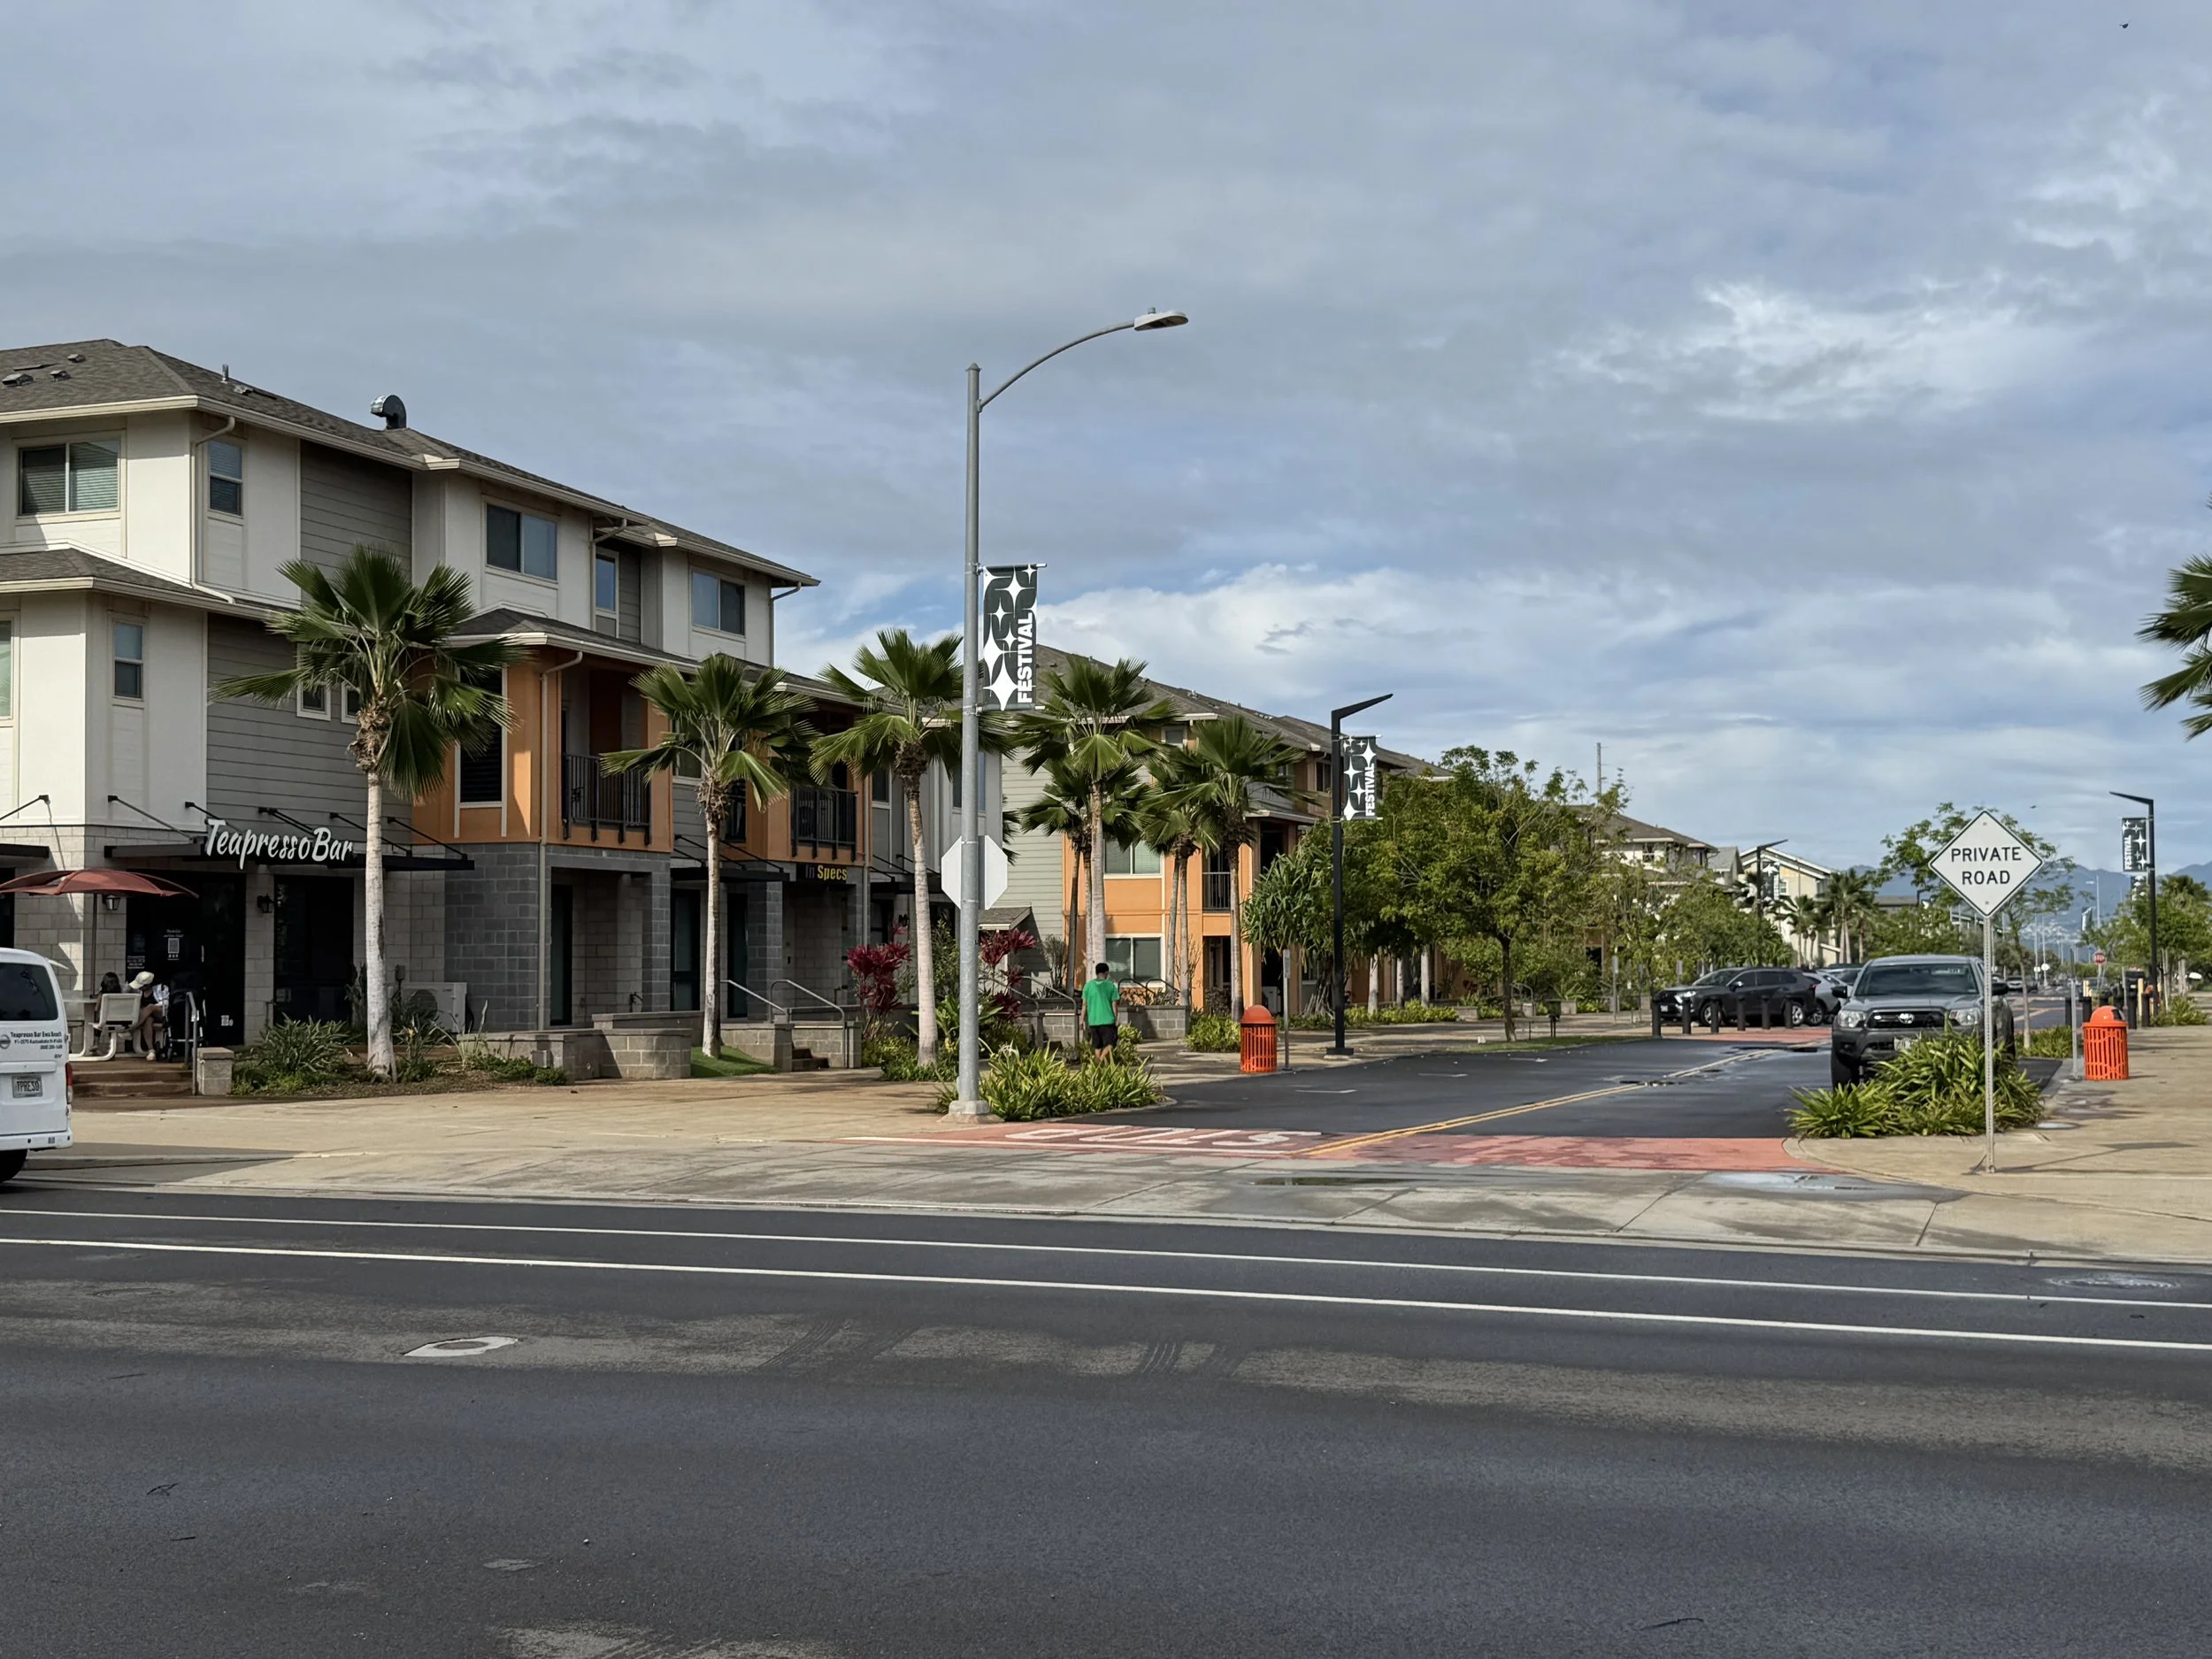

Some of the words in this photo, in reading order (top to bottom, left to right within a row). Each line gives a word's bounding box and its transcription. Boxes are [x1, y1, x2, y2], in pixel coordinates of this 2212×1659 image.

[1018, 612, 1033, 703] FESTIVAL
[1364, 763, 1376, 817] FESTIVAL
[206, 818, 311, 870] Teapresso
[311, 827, 353, 862] Bar
[1951, 847, 2022, 862] PRIVATE
[2124, 834, 2132, 871] FESTIVAL
[817, 864, 848, 881] Specs
[1962, 871, 2010, 885] ROAD
